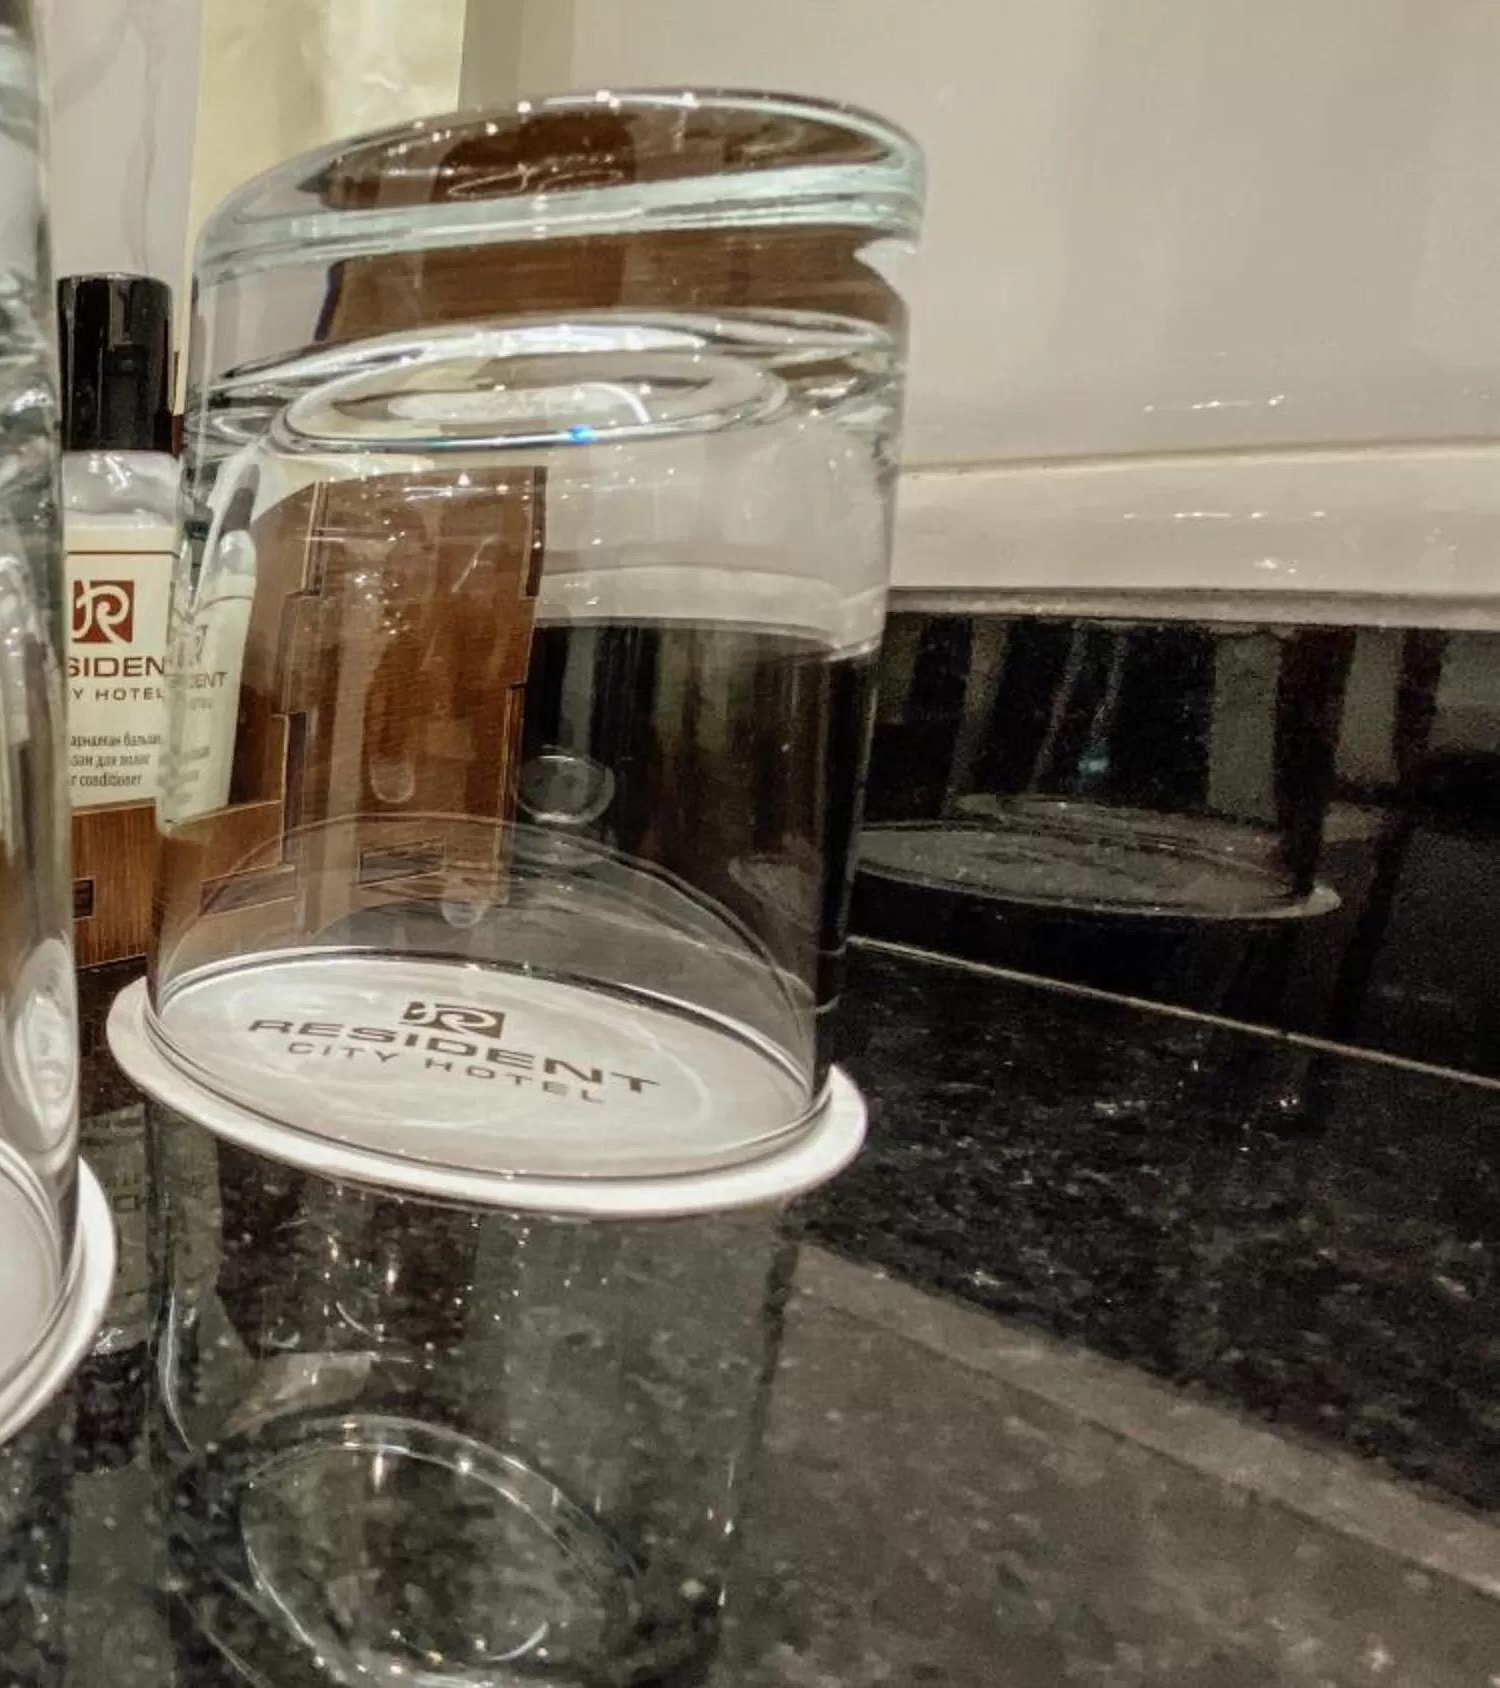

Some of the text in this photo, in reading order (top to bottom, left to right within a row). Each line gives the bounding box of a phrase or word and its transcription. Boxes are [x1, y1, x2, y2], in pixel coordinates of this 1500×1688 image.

[68, 656, 165, 677] SIDEN
[95, 687, 165, 701] HOTEL
[248, 1019, 660, 1094] RESIDENT
[287, 1041, 606, 1104] CITY HOTEL
